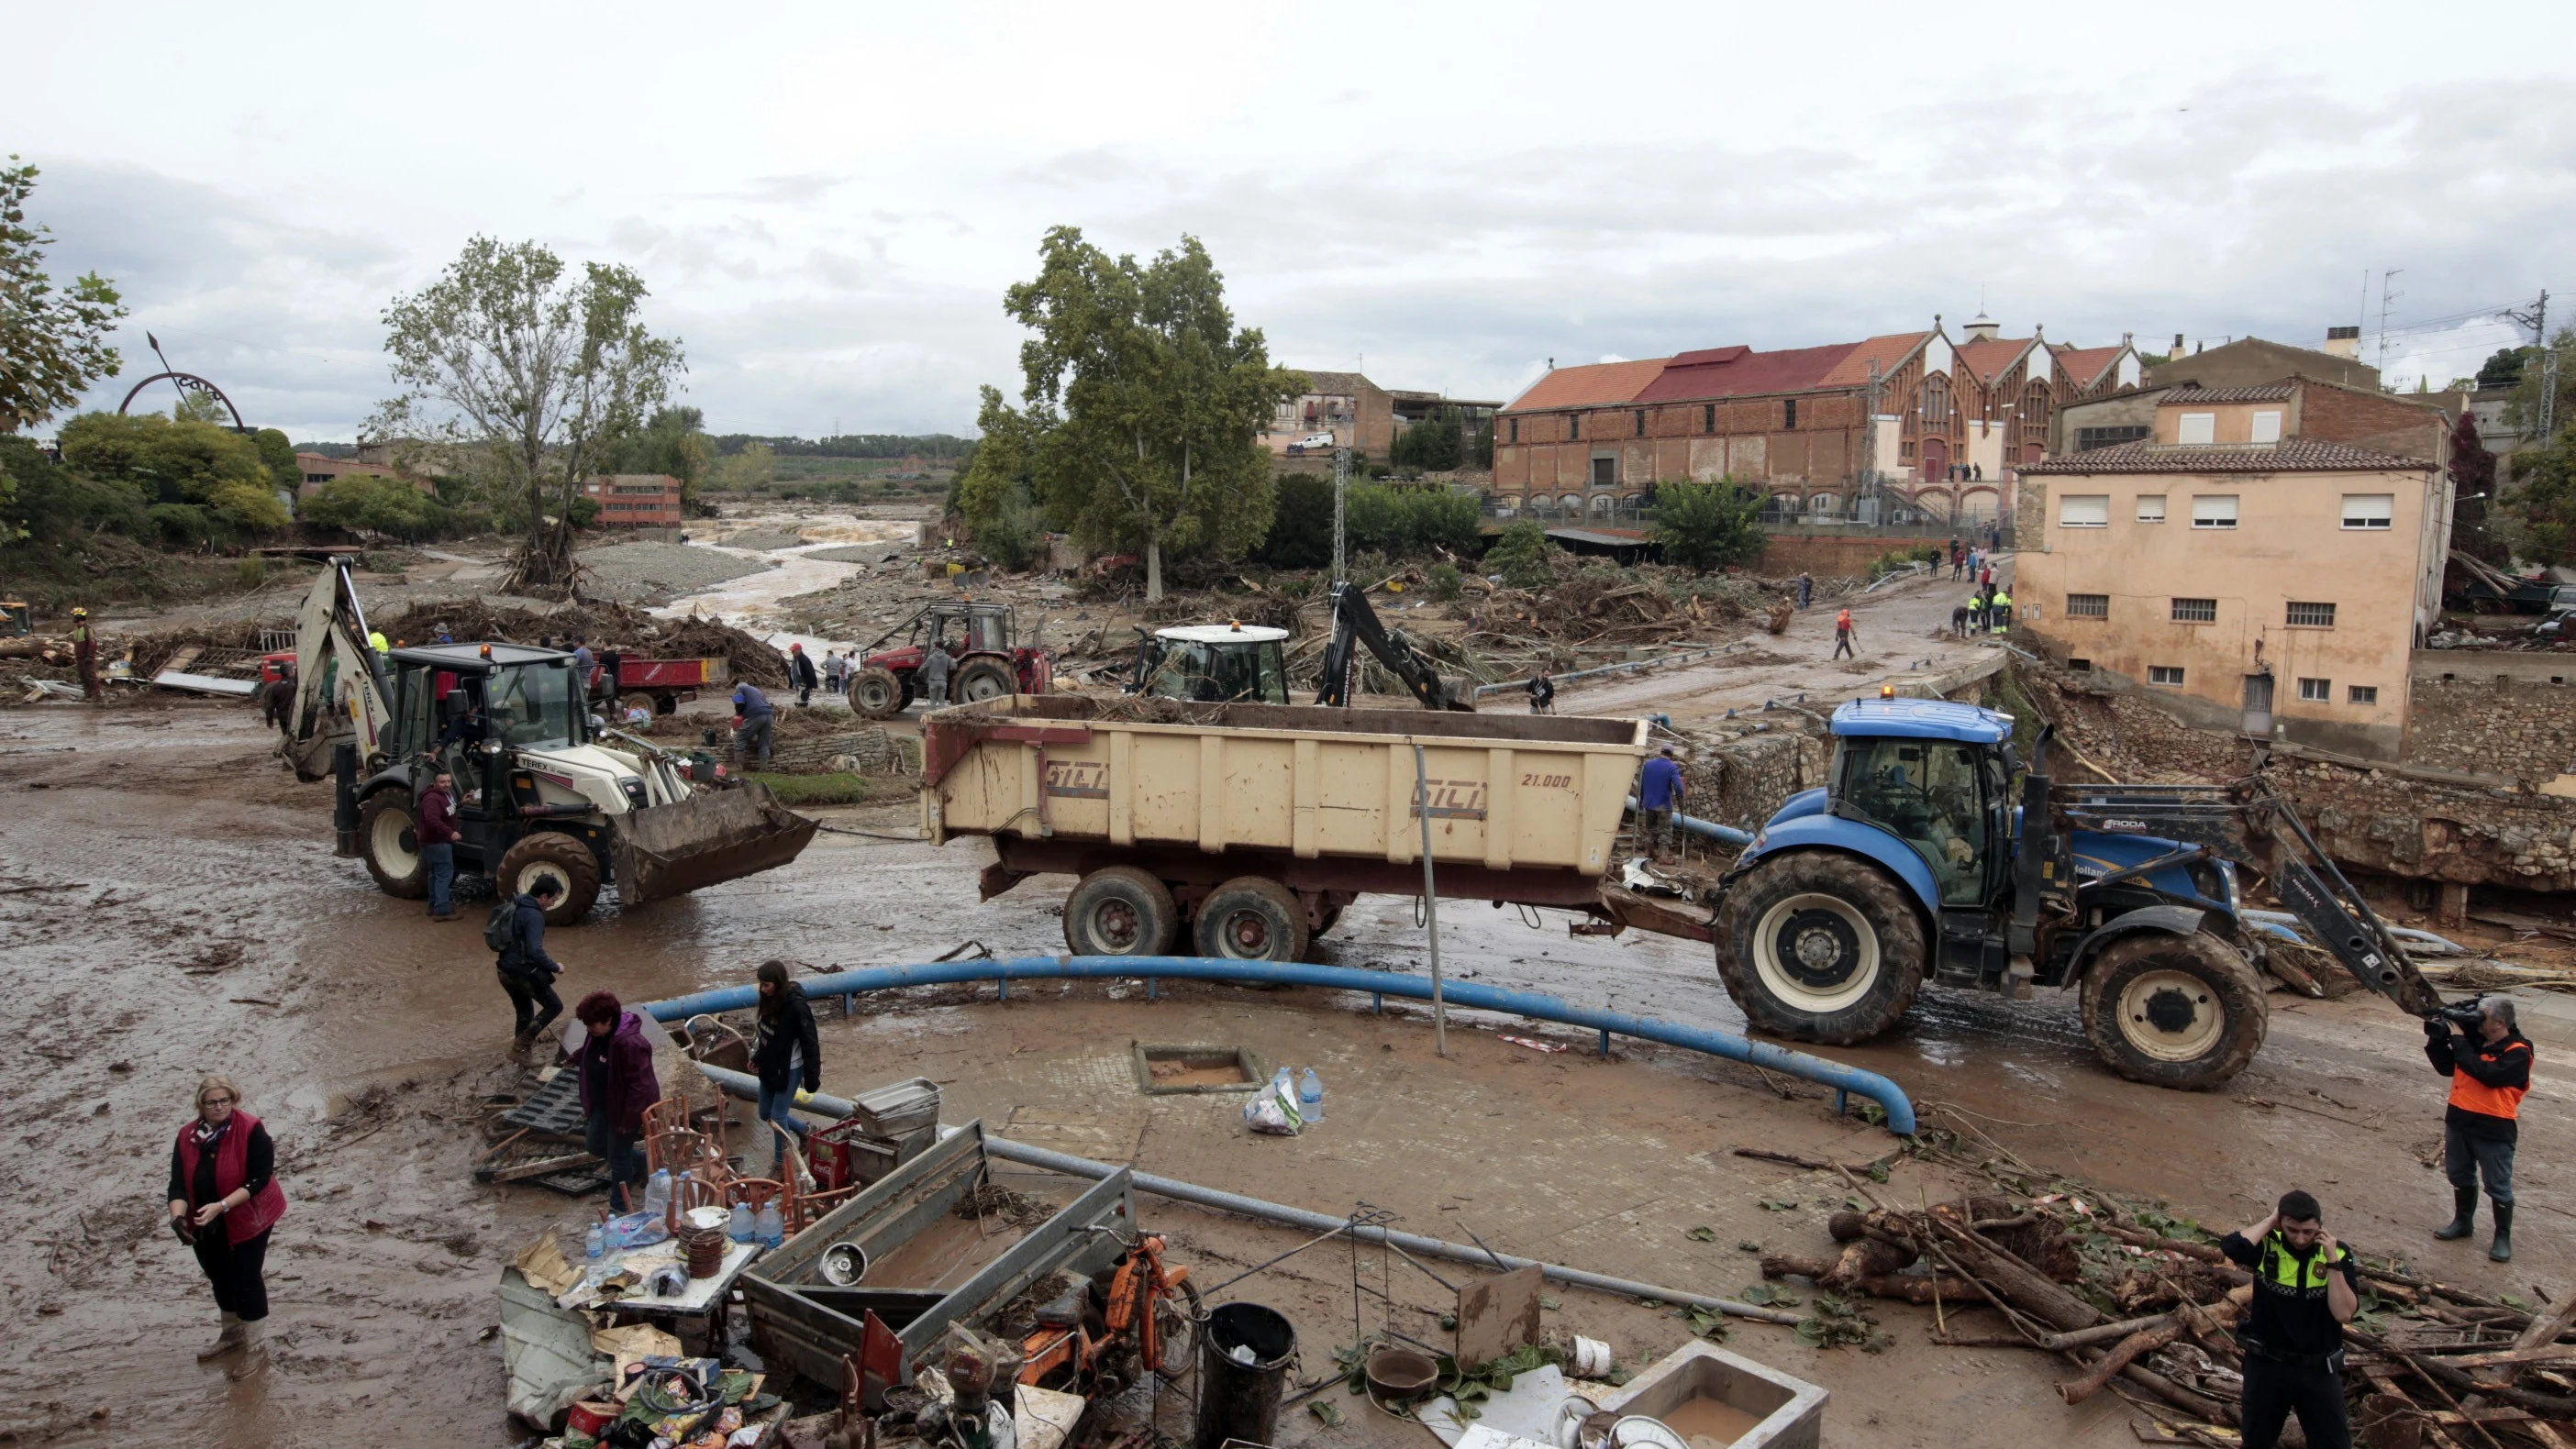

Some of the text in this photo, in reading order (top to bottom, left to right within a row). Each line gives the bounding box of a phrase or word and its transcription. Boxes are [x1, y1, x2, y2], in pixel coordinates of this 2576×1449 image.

[363, 681, 374, 713] TEREX
[522, 758, 548, 770] TEREX
[1521, 774, 1571, 788] 21.000
[2112, 820, 2147, 829] RODA
